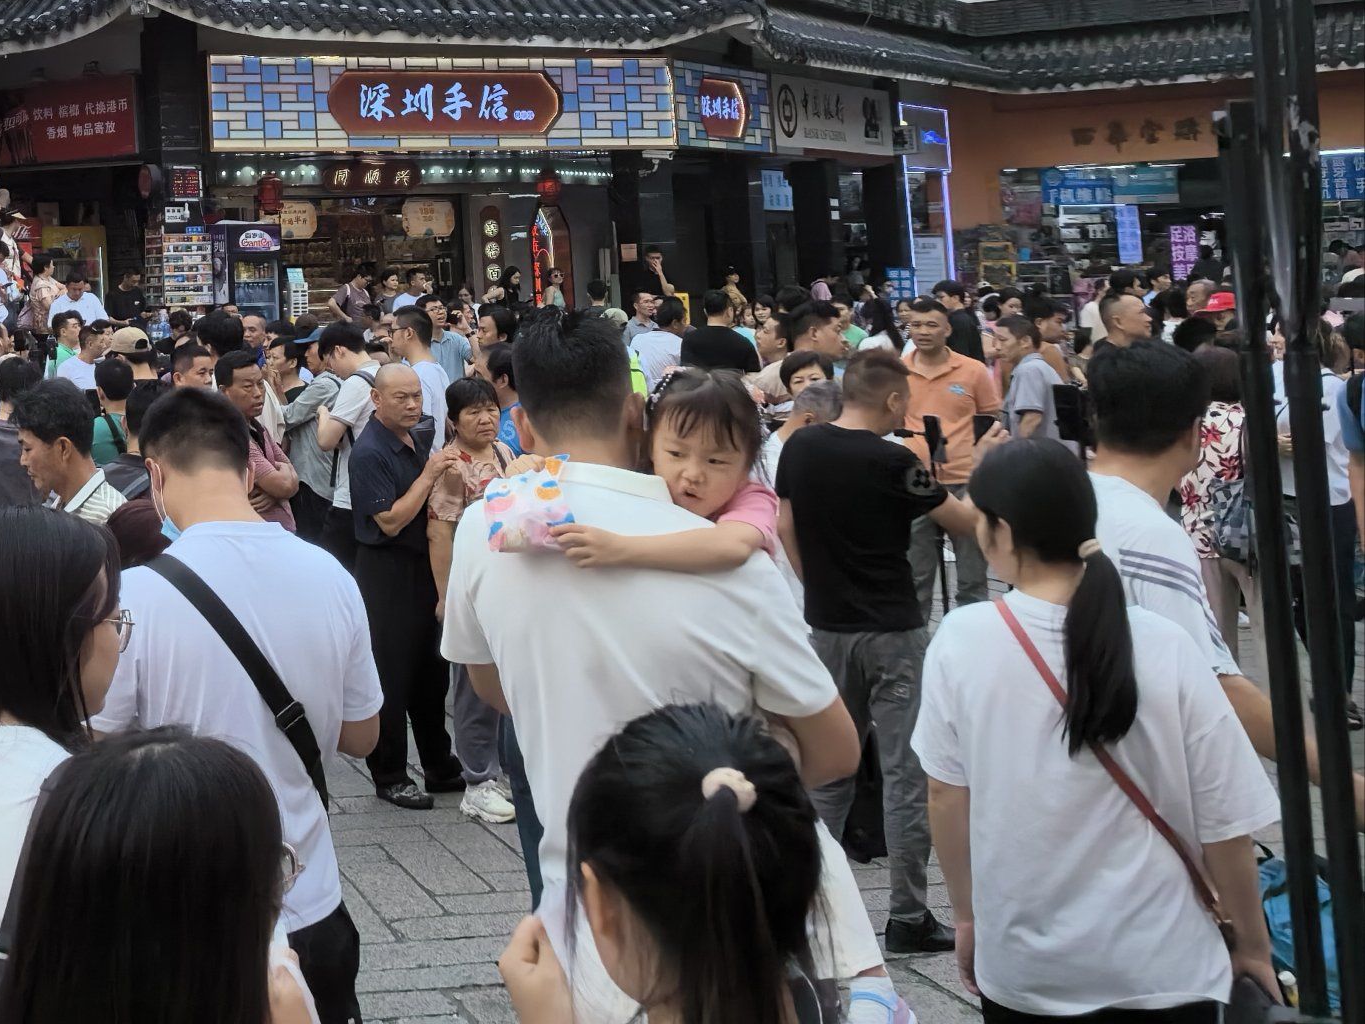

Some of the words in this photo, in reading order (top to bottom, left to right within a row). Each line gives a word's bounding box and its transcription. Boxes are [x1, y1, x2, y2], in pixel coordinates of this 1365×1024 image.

[33, 107, 53, 121] 饮料
[84, 98, 128, 115] 代换港币
[360, 82, 509, 122] 深圳手信
[46, 126, 68, 140] 香烟
[72, 121, 116, 138] 物品寄放
[1170, 226, 1196, 242] 足浴
[1171, 245, 1199, 262] 按摩
